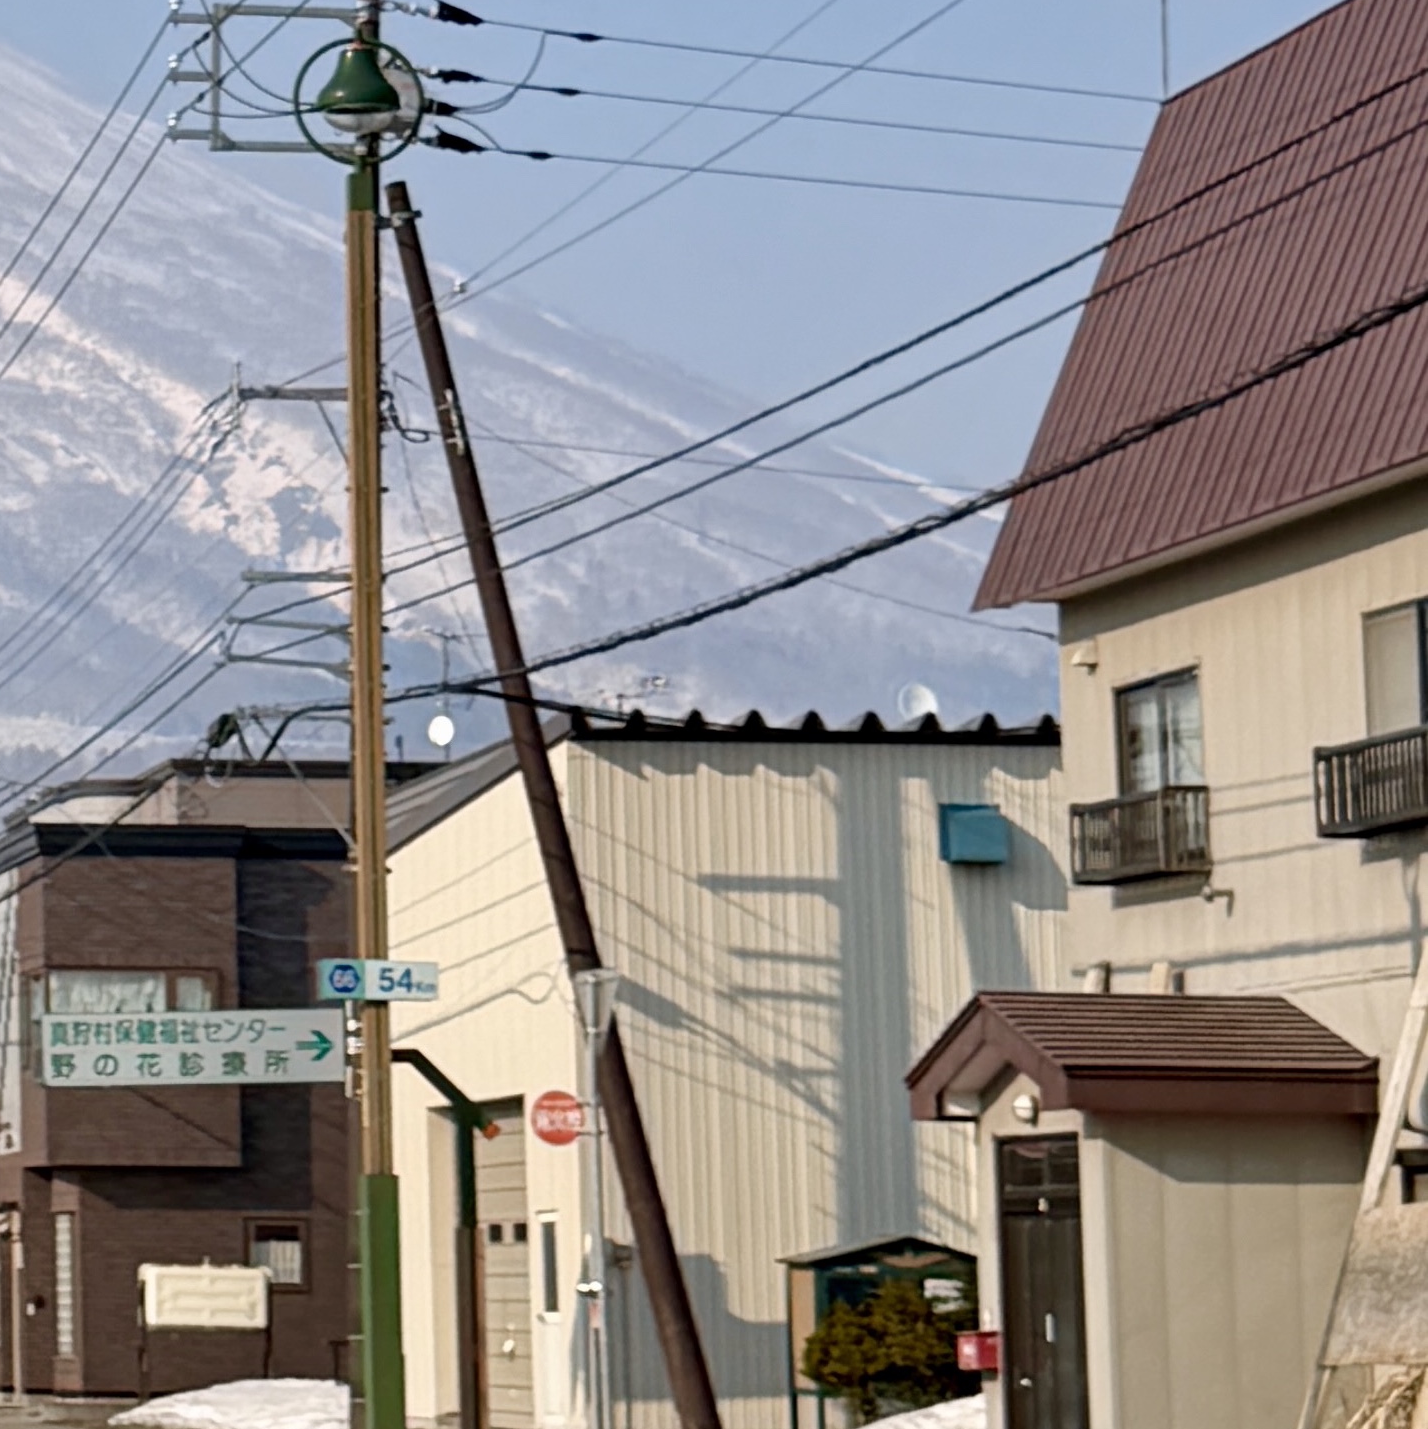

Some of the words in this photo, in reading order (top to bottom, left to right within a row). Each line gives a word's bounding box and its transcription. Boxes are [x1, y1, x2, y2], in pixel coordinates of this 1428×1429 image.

[50, 1049, 292, 1080] 野の花診療所
